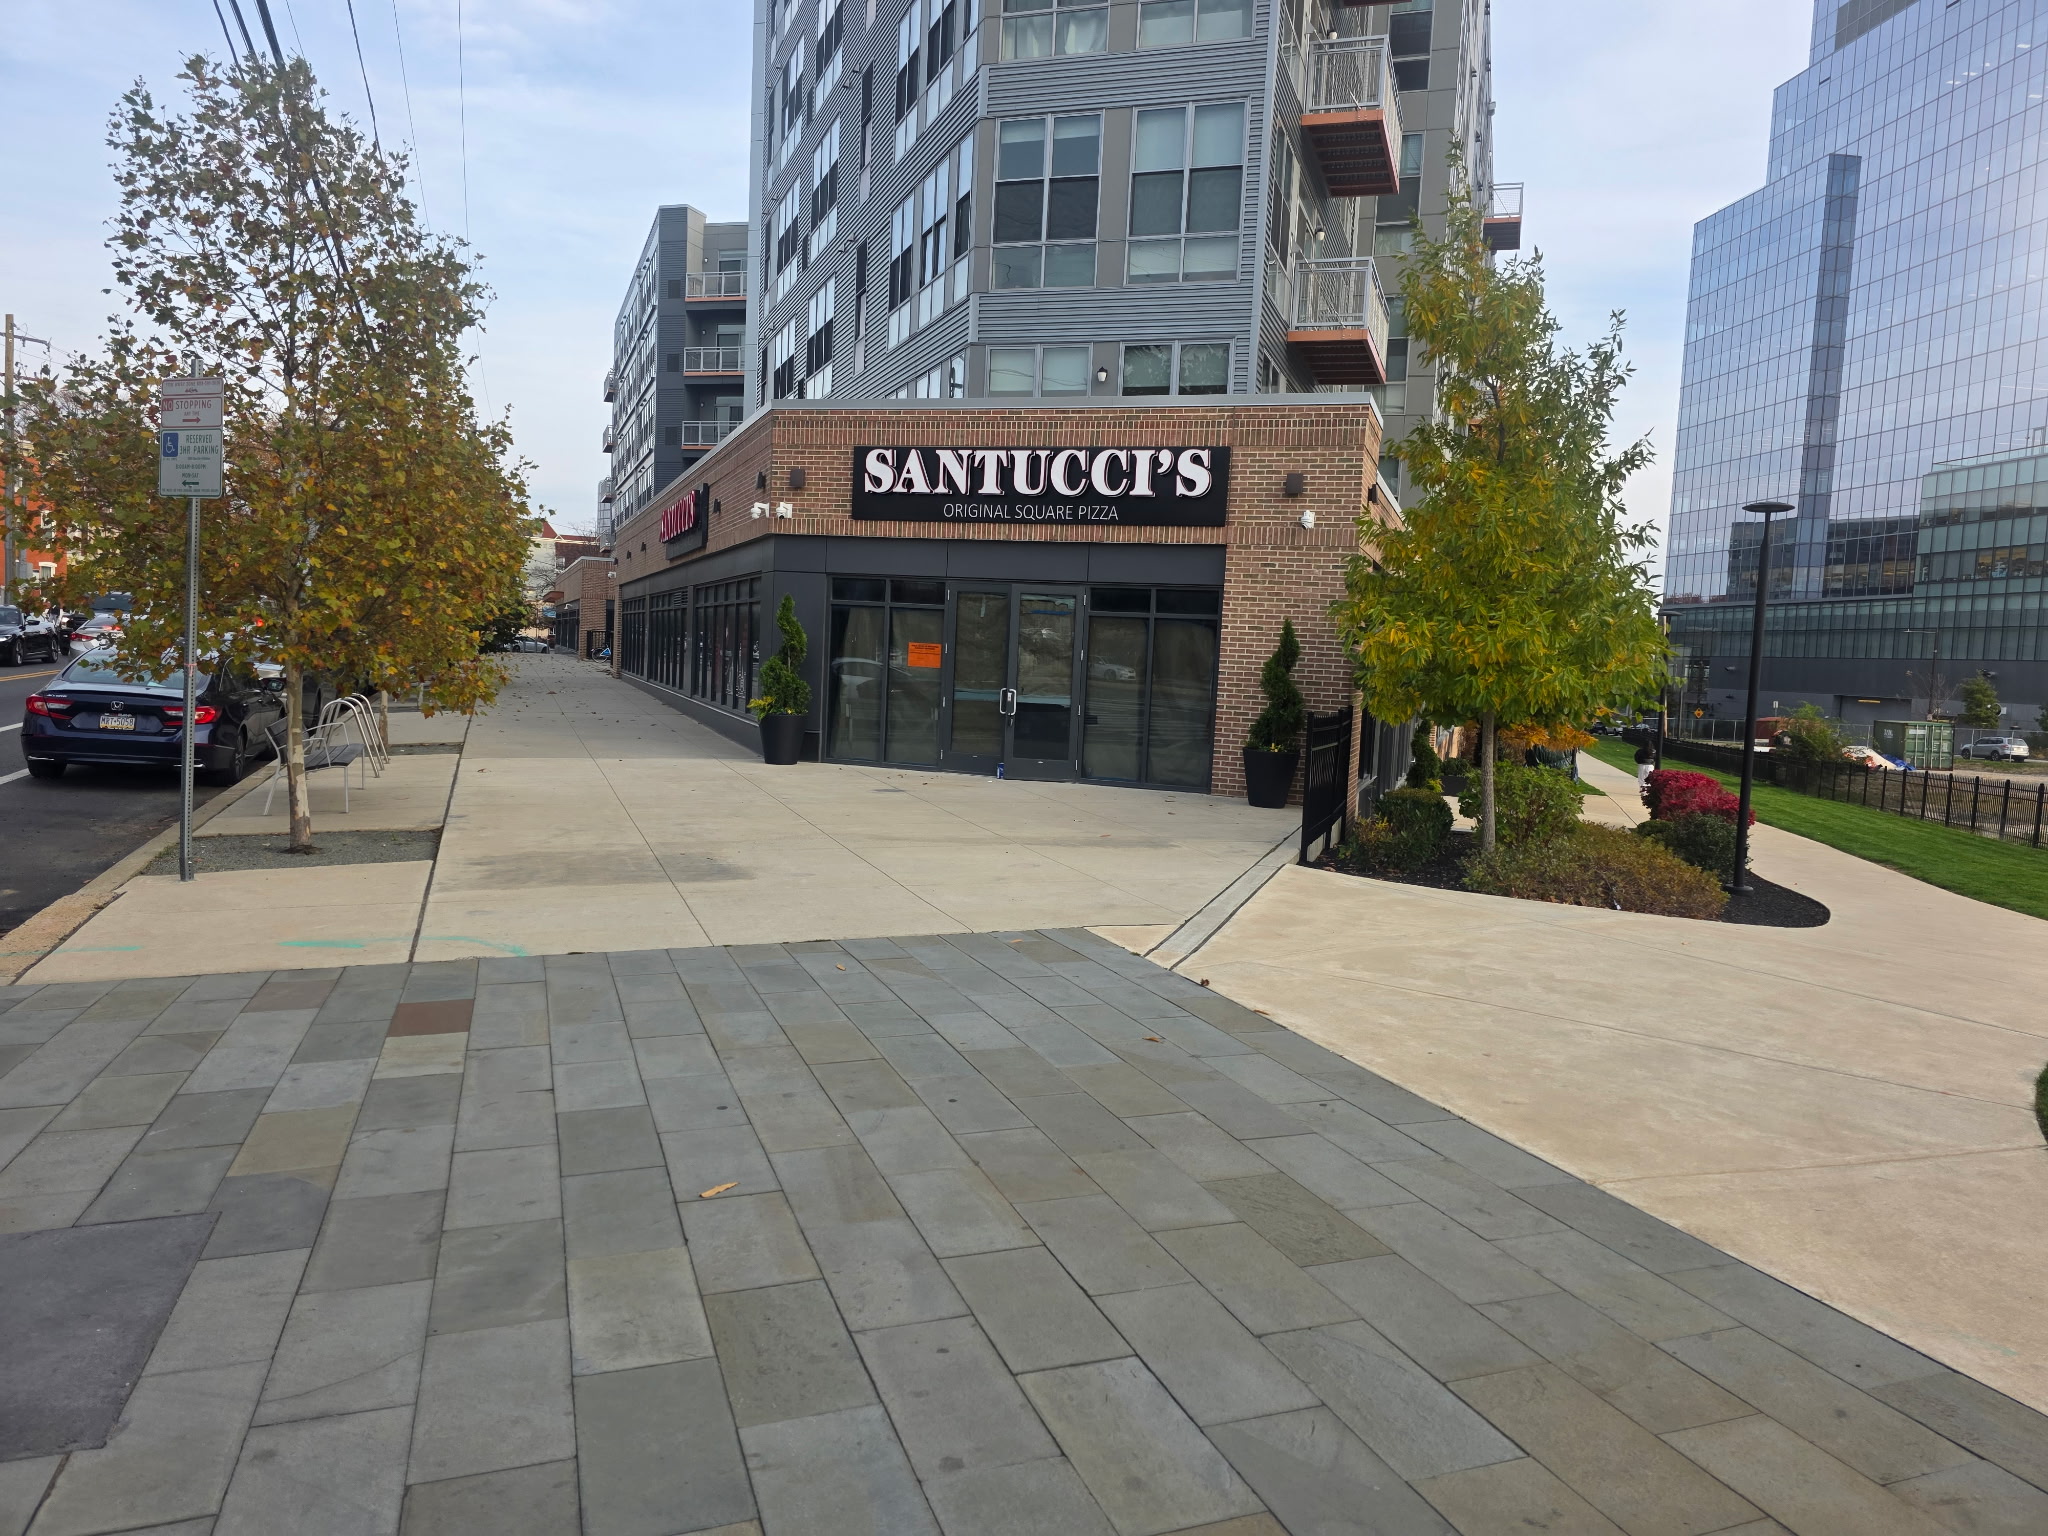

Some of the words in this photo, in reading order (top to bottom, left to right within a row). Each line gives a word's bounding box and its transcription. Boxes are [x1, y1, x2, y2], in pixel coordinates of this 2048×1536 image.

[163, 400, 173, 411] NO
[175, 400, 212, 410] STOPPING
[186, 434, 213, 444] RESERVED
[180, 446, 191, 455] 3HR
[193, 445, 219, 455] PARKING
[864, 448, 1213, 498] SANTUCCI'S
[943, 503, 1011, 519] ORIGINAL
[1014, 504, 1073, 521] SQUARE
[1078, 505, 1119, 521] PIZZA
